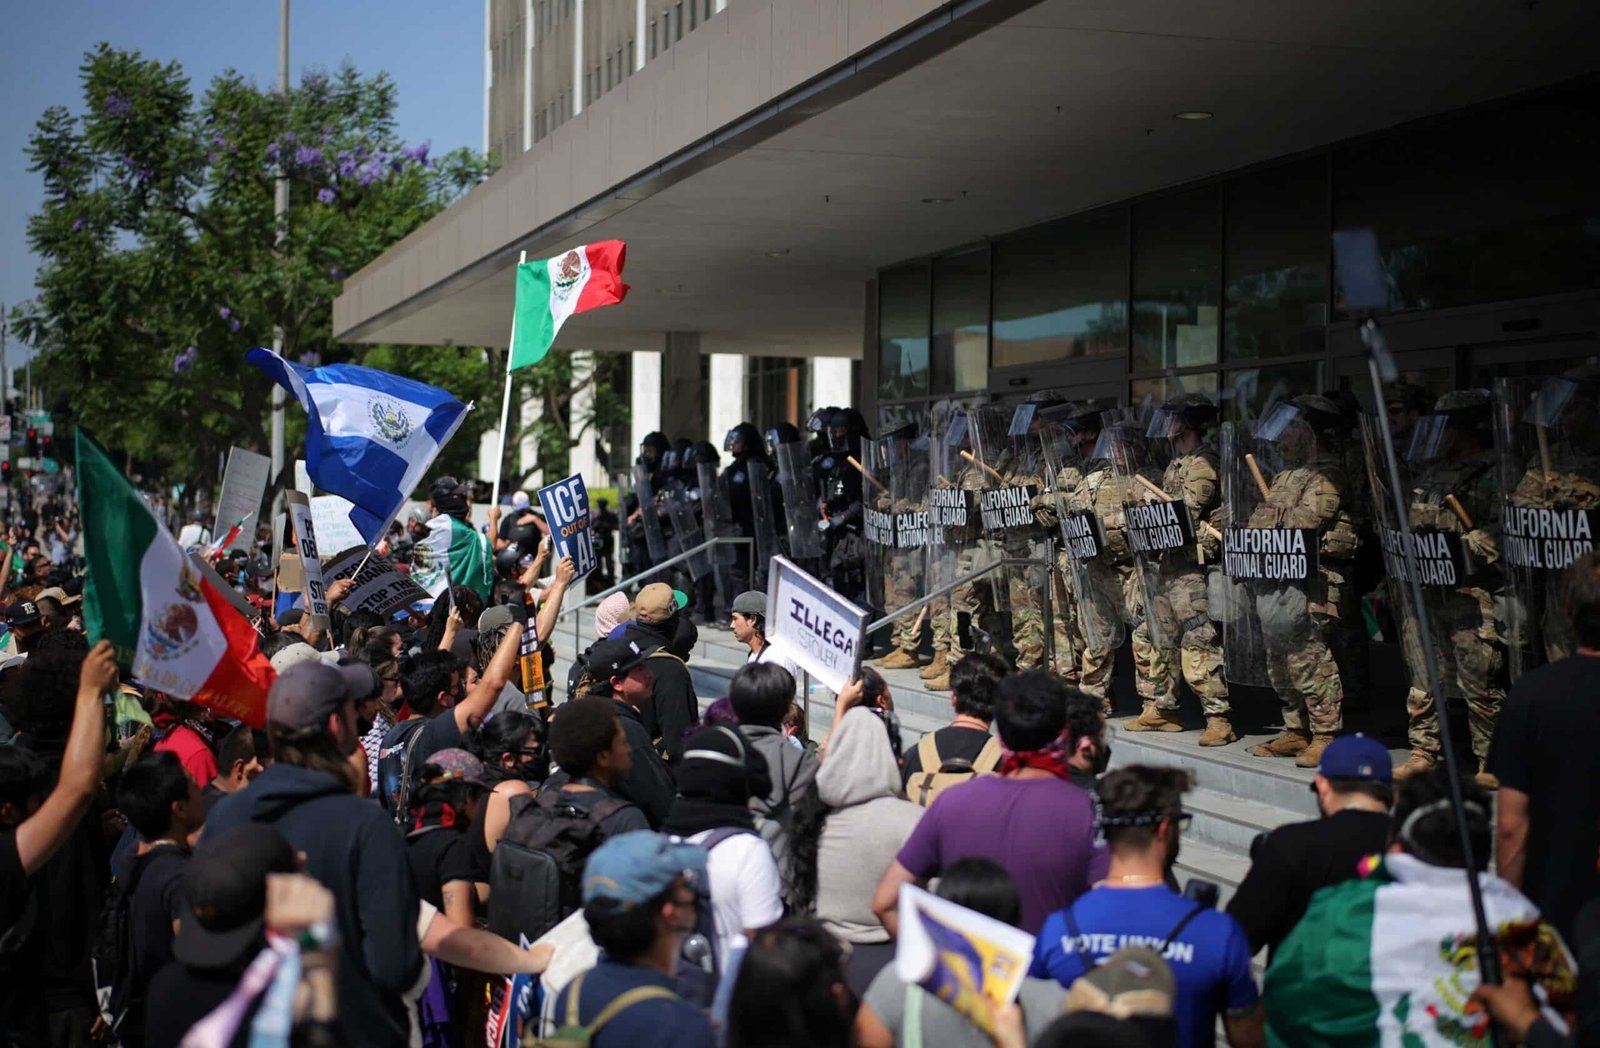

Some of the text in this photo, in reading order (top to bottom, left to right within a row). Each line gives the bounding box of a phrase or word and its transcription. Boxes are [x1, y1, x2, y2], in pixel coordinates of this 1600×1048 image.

[546, 479, 587, 527] ICE
[981, 487, 1030, 510] ALIFORNIA
[560, 517, 588, 538] OUT OF
[897, 511, 929, 530] CALIFO
[942, 508, 967, 526] GUARD
[1004, 505, 1034, 527] GUARD
[1503, 506, 1592, 539] ALIFORNIA
[897, 528, 933, 548] NATIONA
[1149, 524, 1184, 550] GUARD
[1225, 528, 1306, 553] CALIFORNIA
[1225, 553, 1307, 579] NATIONAL GUARD
[356, 579, 416, 611] STOP THE
[1061, 933, 1117, 954] VOTE
